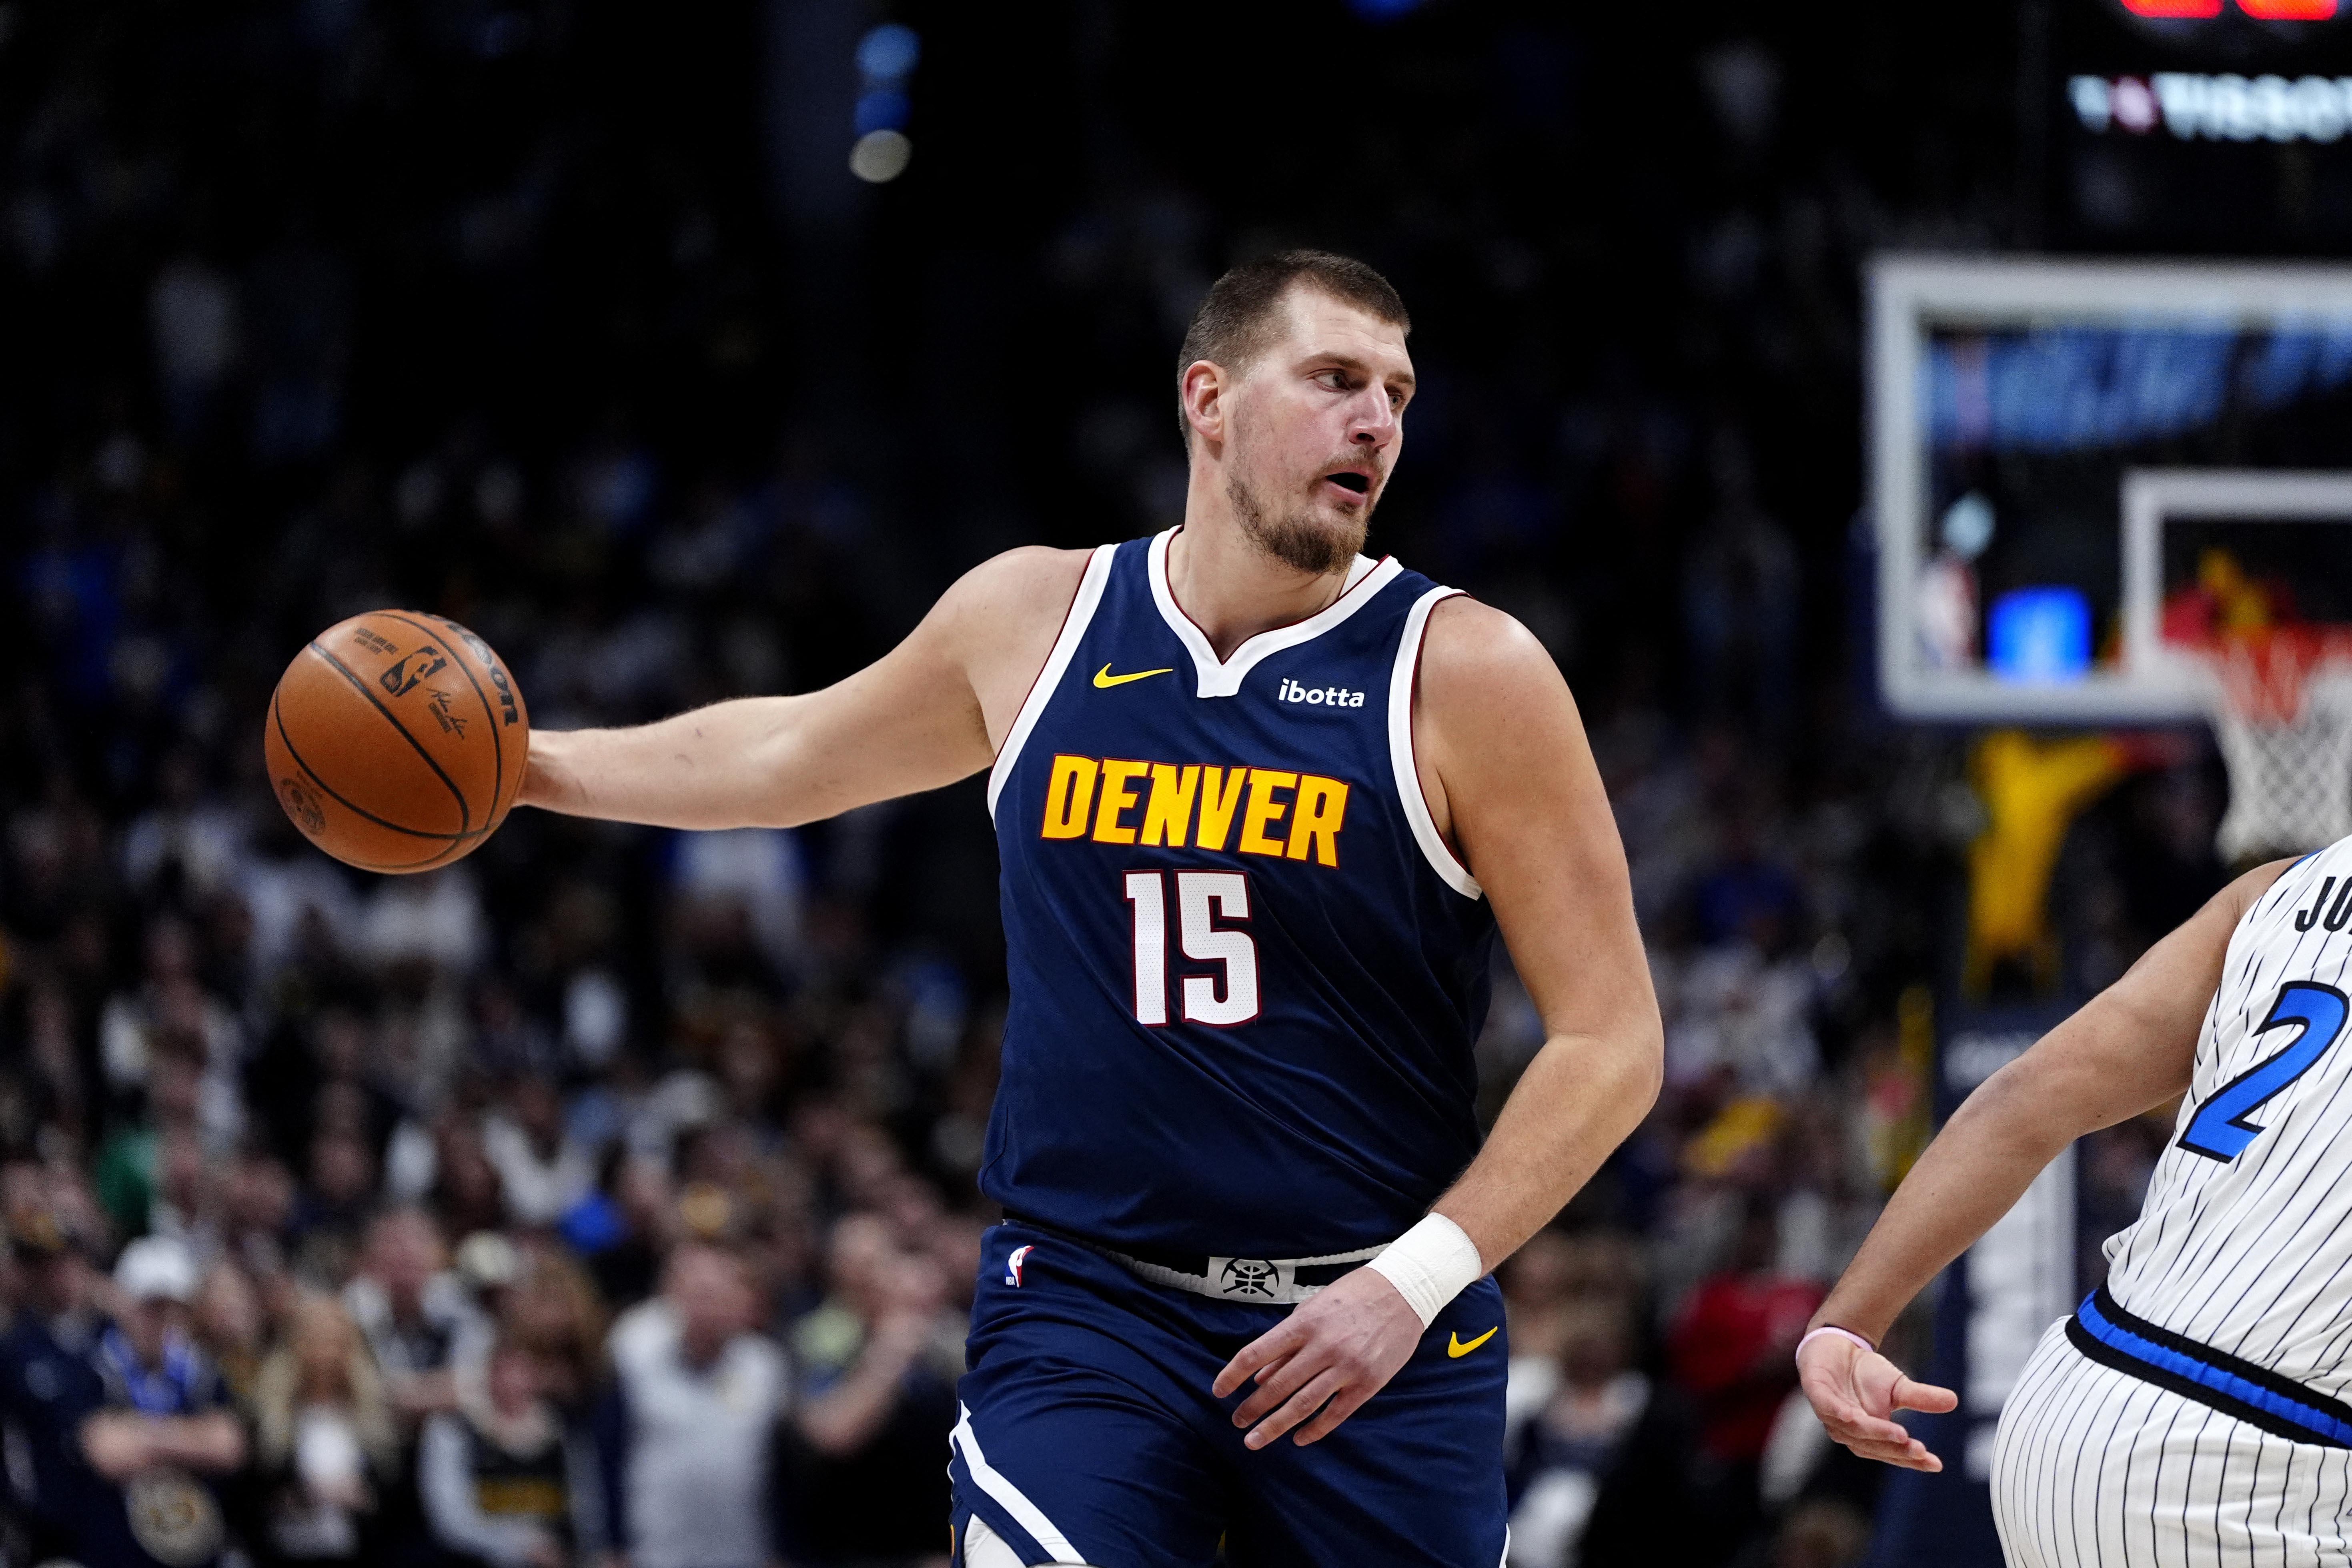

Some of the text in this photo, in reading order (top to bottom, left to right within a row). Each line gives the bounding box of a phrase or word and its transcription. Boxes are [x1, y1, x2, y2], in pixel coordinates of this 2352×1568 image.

[1278, 678, 1365, 707] ibotta
[1041, 753, 1351, 869] DENVER
[1122, 869, 1262, 1027] 15
[2294, 876, 2352, 935] JO
[2176, 980, 2350, 1163] 2
[1006, 1276, 1015, 1285] NBA
